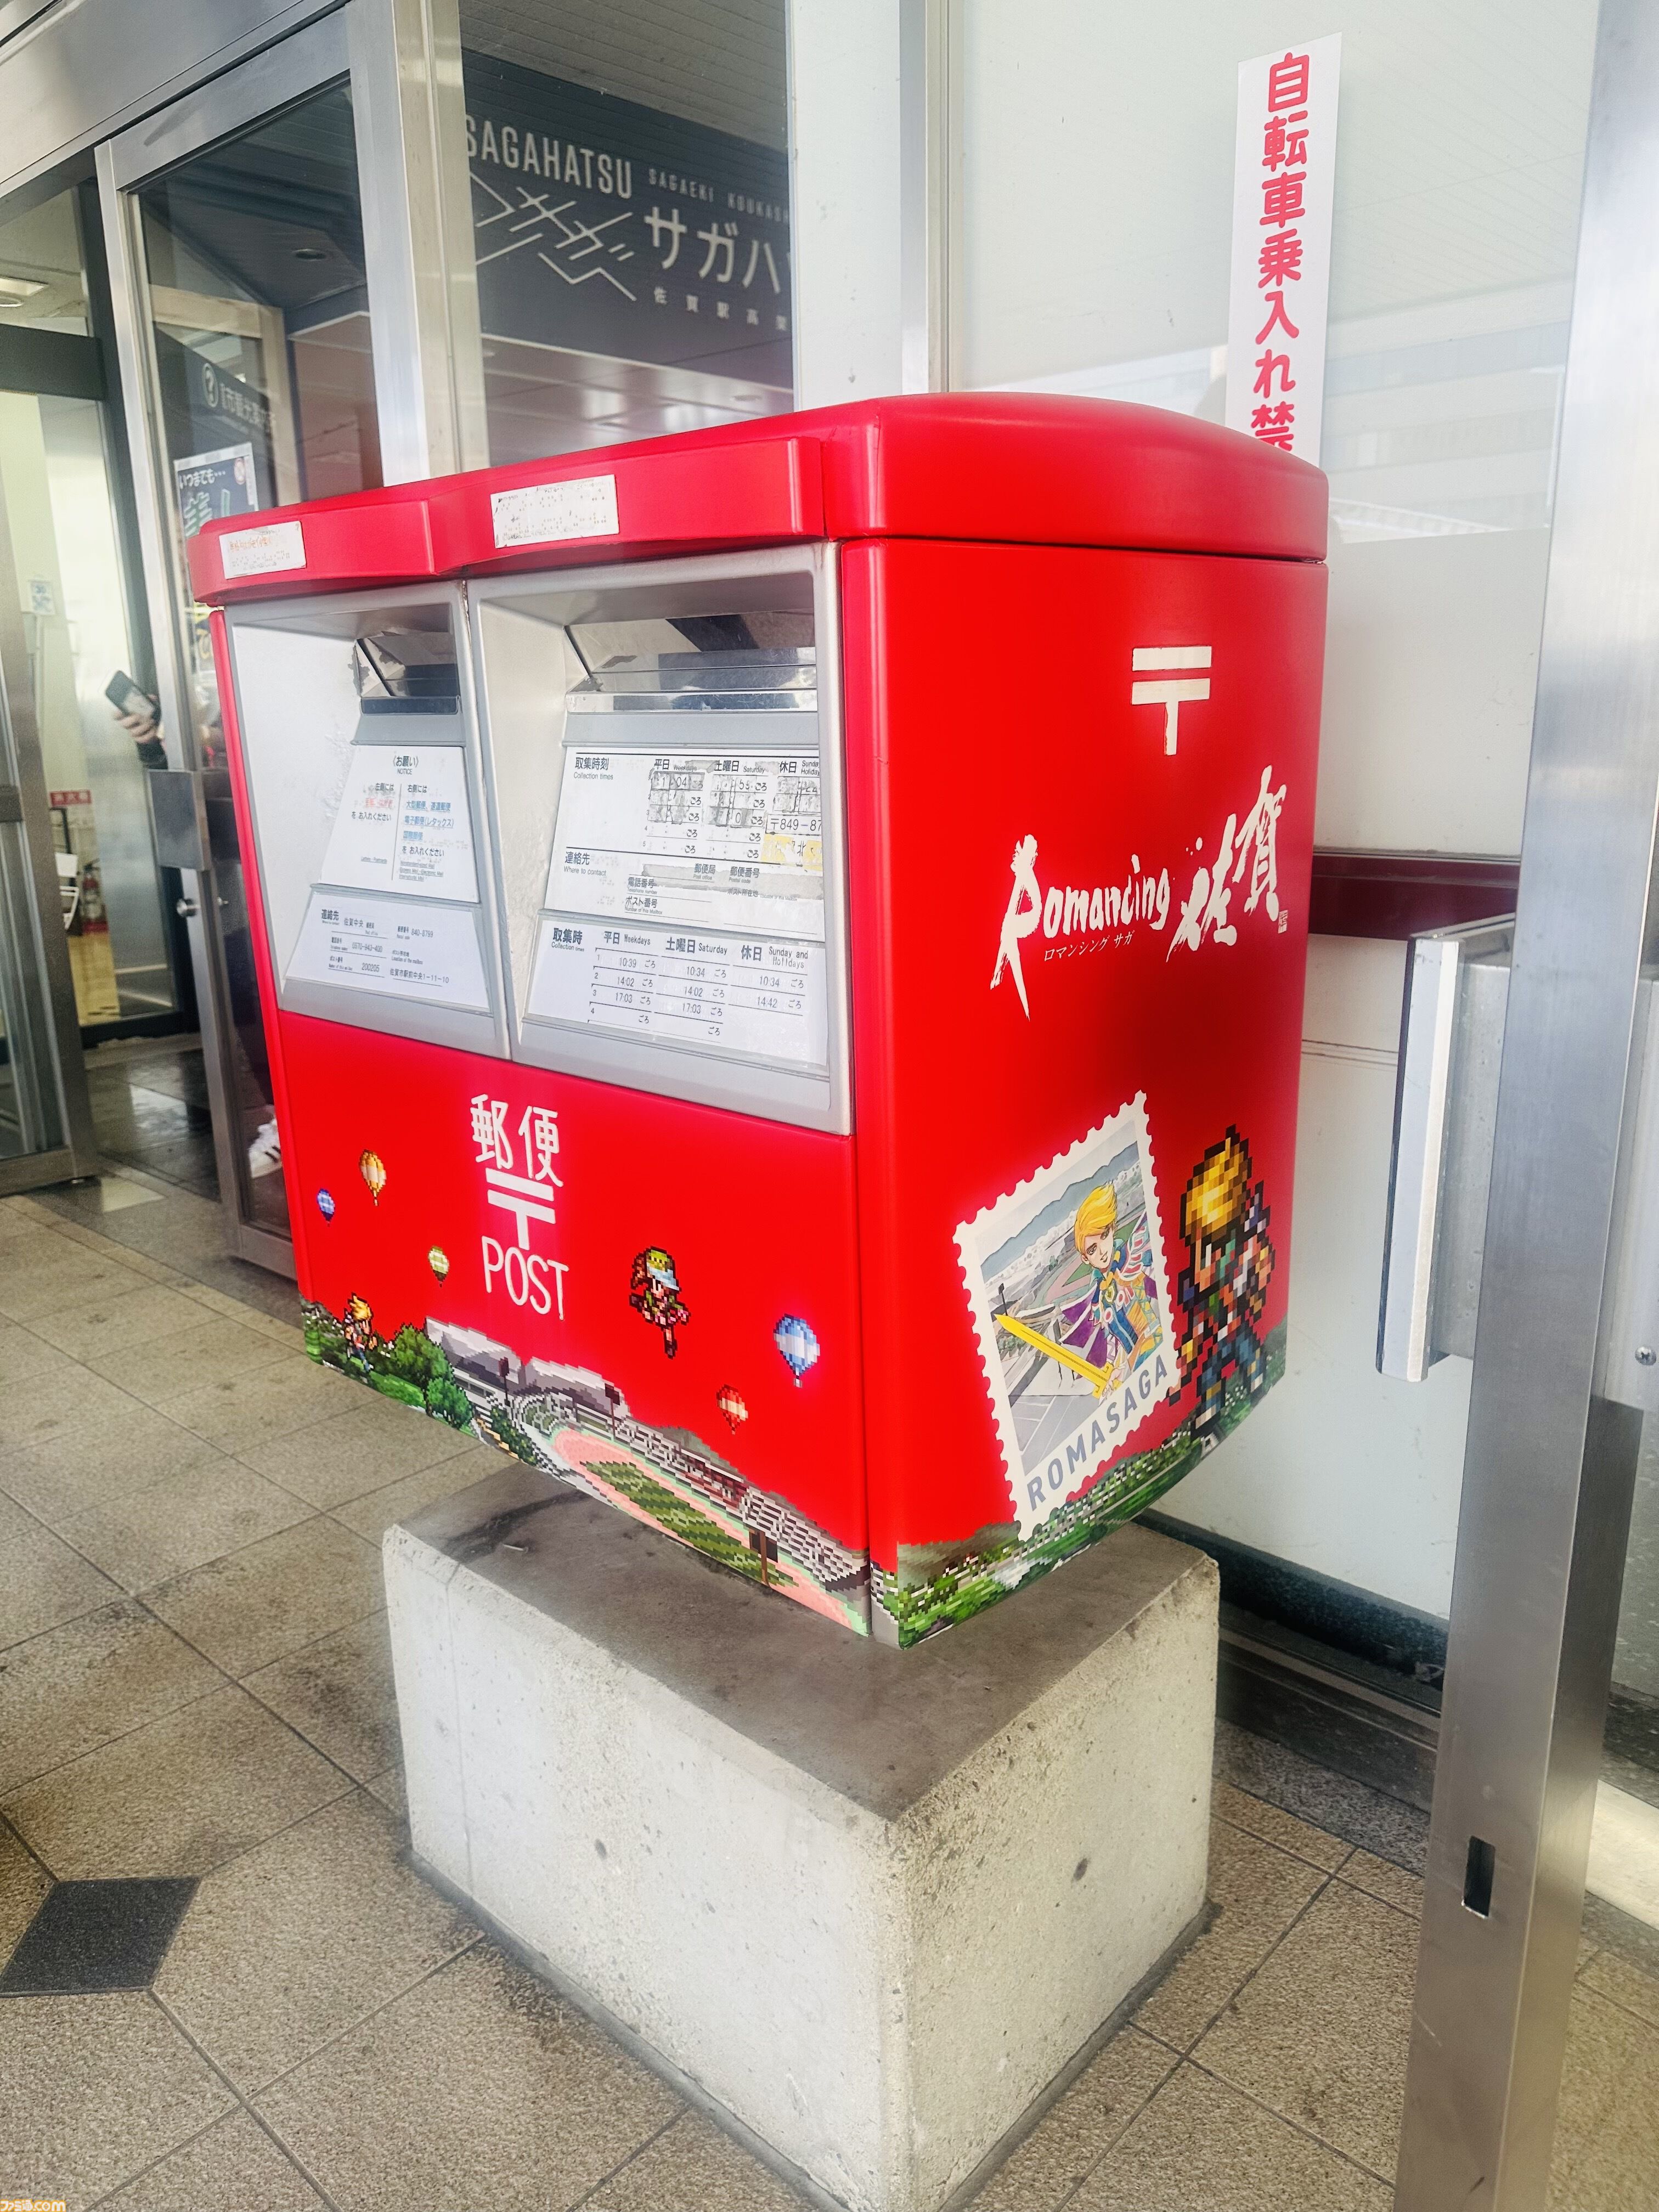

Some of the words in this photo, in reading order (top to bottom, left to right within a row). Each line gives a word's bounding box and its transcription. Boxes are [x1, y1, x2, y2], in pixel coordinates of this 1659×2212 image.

[466, 115, 631, 199] SAGAHATSU
[649, 168, 714, 202] SAGAEKI
[644, 206, 791, 294] サガハ
[575, 757, 609, 770] 取集時刻
[654, 759, 670, 770] 平日
[714, 760, 739, 772] 土曜日
[780, 761, 797, 773] 休日
[755, 782, 767, 791] ごろ
[690, 797, 702, 805] ごろ
[753, 799, 765, 808] ごろ
[689, 813, 699, 821] ごろ
[751, 816, 763, 825] ごろ
[686, 829, 698, 838] ごろ
[749, 833, 761, 842] ごろ
[685, 845, 696, 854] ごろ
[747, 850, 759, 858] ごろ
[565, 851, 590, 865] 連絡先
[564, 866, 579, 874] Where
[694, 863, 716, 874] 郵便局
[730, 866, 760, 878] 郵便番号
[628, 877, 654, 888] 電話番号
[625, 896, 657, 908] ポスト番号
[321, 909, 339, 921] 連絡先
[344, 918, 364, 928] 佐賀中央
[990, 834, 1170, 1022] Romancing
[552, 927, 583, 945] 取集時
[604, 931, 620, 945] 平日
[624, 934, 651, 946] Weekdays
[551, 941, 574, 951] Collection
[665, 936, 696, 953] 土曜日
[698, 943, 727, 955] Saturday
[1044, 935, 1110, 961] ロマンシング
[1114, 929, 1135, 948] サガ
[741, 945, 762, 961] 休日
[769, 946, 792, 958] Sunday
[796, 950, 808, 959] and
[619, 957, 636, 968] 10:39
[645, 960, 656, 969] ごろ
[687, 966, 706, 977] 10:34
[714, 968, 726, 978] ごろ
[617, 976, 635, 987] 14:02
[642, 978, 653, 988] ごろ
[760, 975, 780, 988] 10:34
[791, 978, 804, 989] ごろ
[684, 986, 703, 997] 14:02
[713, 988, 725, 998] ごろ
[616, 992, 633, 1003] 17:03
[640, 996, 651, 1005] ごろ
[757, 996, 777, 1009] 14:42
[788, 999, 802, 1009] ごろ
[682, 1003, 701, 1014] 17:03
[710, 1007, 723, 1017] ごろ
[639, 1015, 649, 1024] ごろ
[708, 1026, 720, 1036] ごろ
[470, 1093, 563, 1187] 郵便
[482, 1235, 569, 1321] POST
[1027, 1355, 1168, 1511] ROMASAGA
